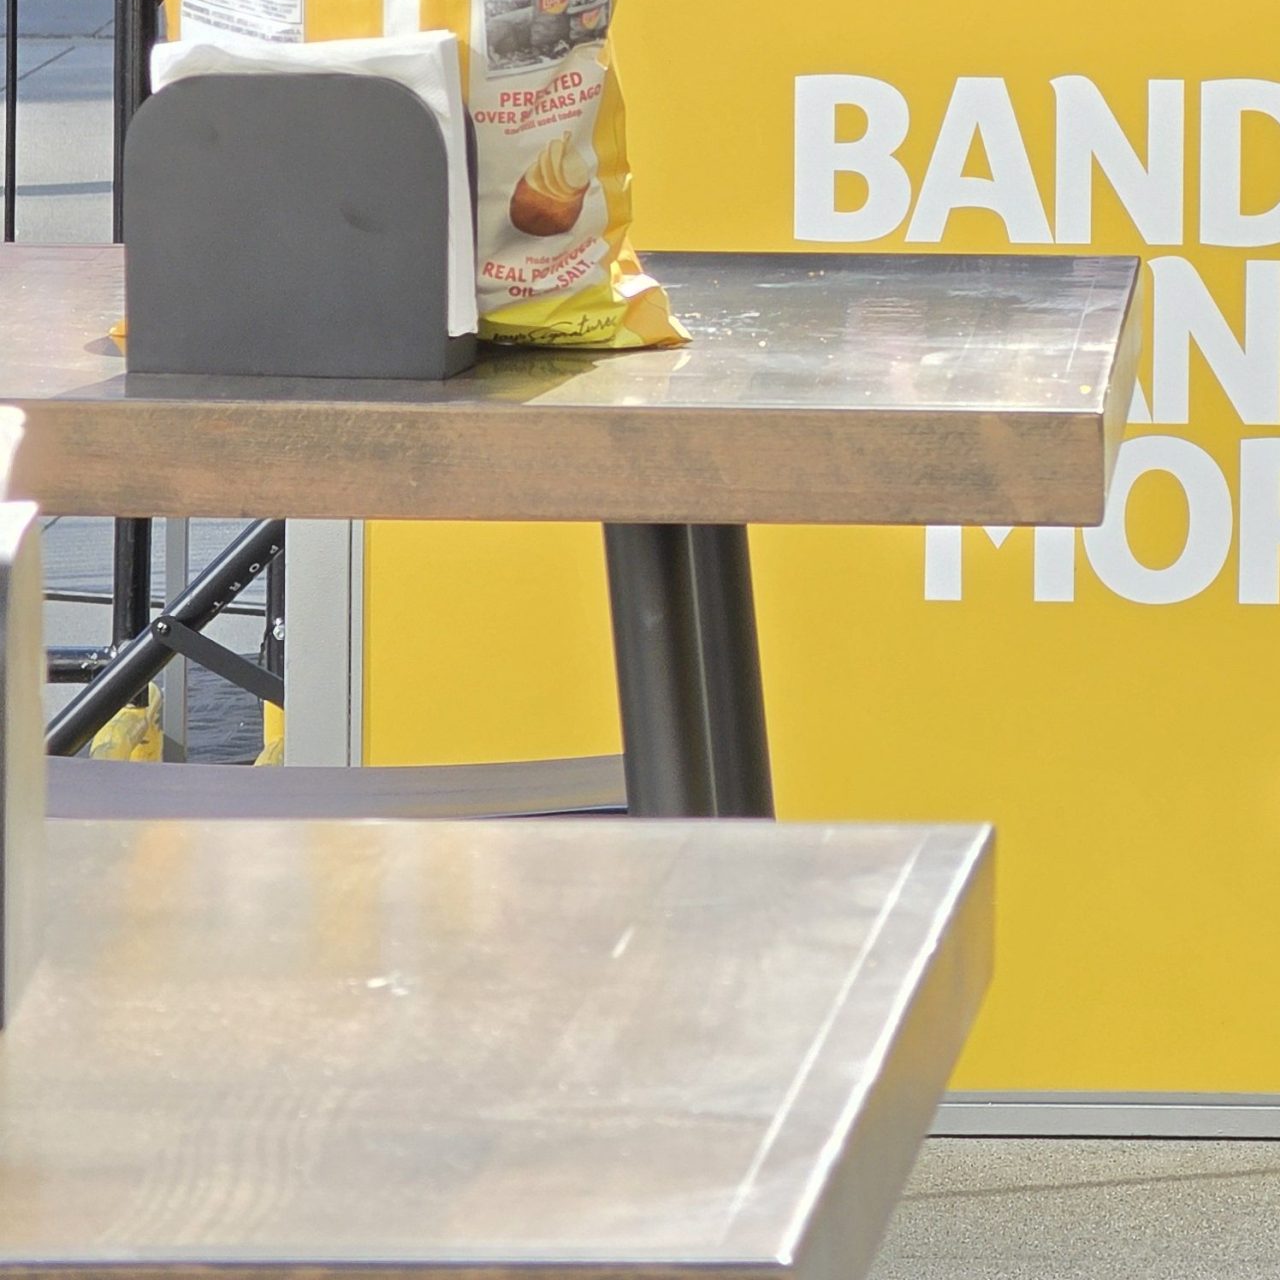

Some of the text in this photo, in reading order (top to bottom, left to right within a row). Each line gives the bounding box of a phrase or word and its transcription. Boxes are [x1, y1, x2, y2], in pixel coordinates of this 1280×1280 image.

[474, 110, 517, 124] OVER
[578, 83, 602, 103] AGO
[482, 260, 527, 283] REAL
